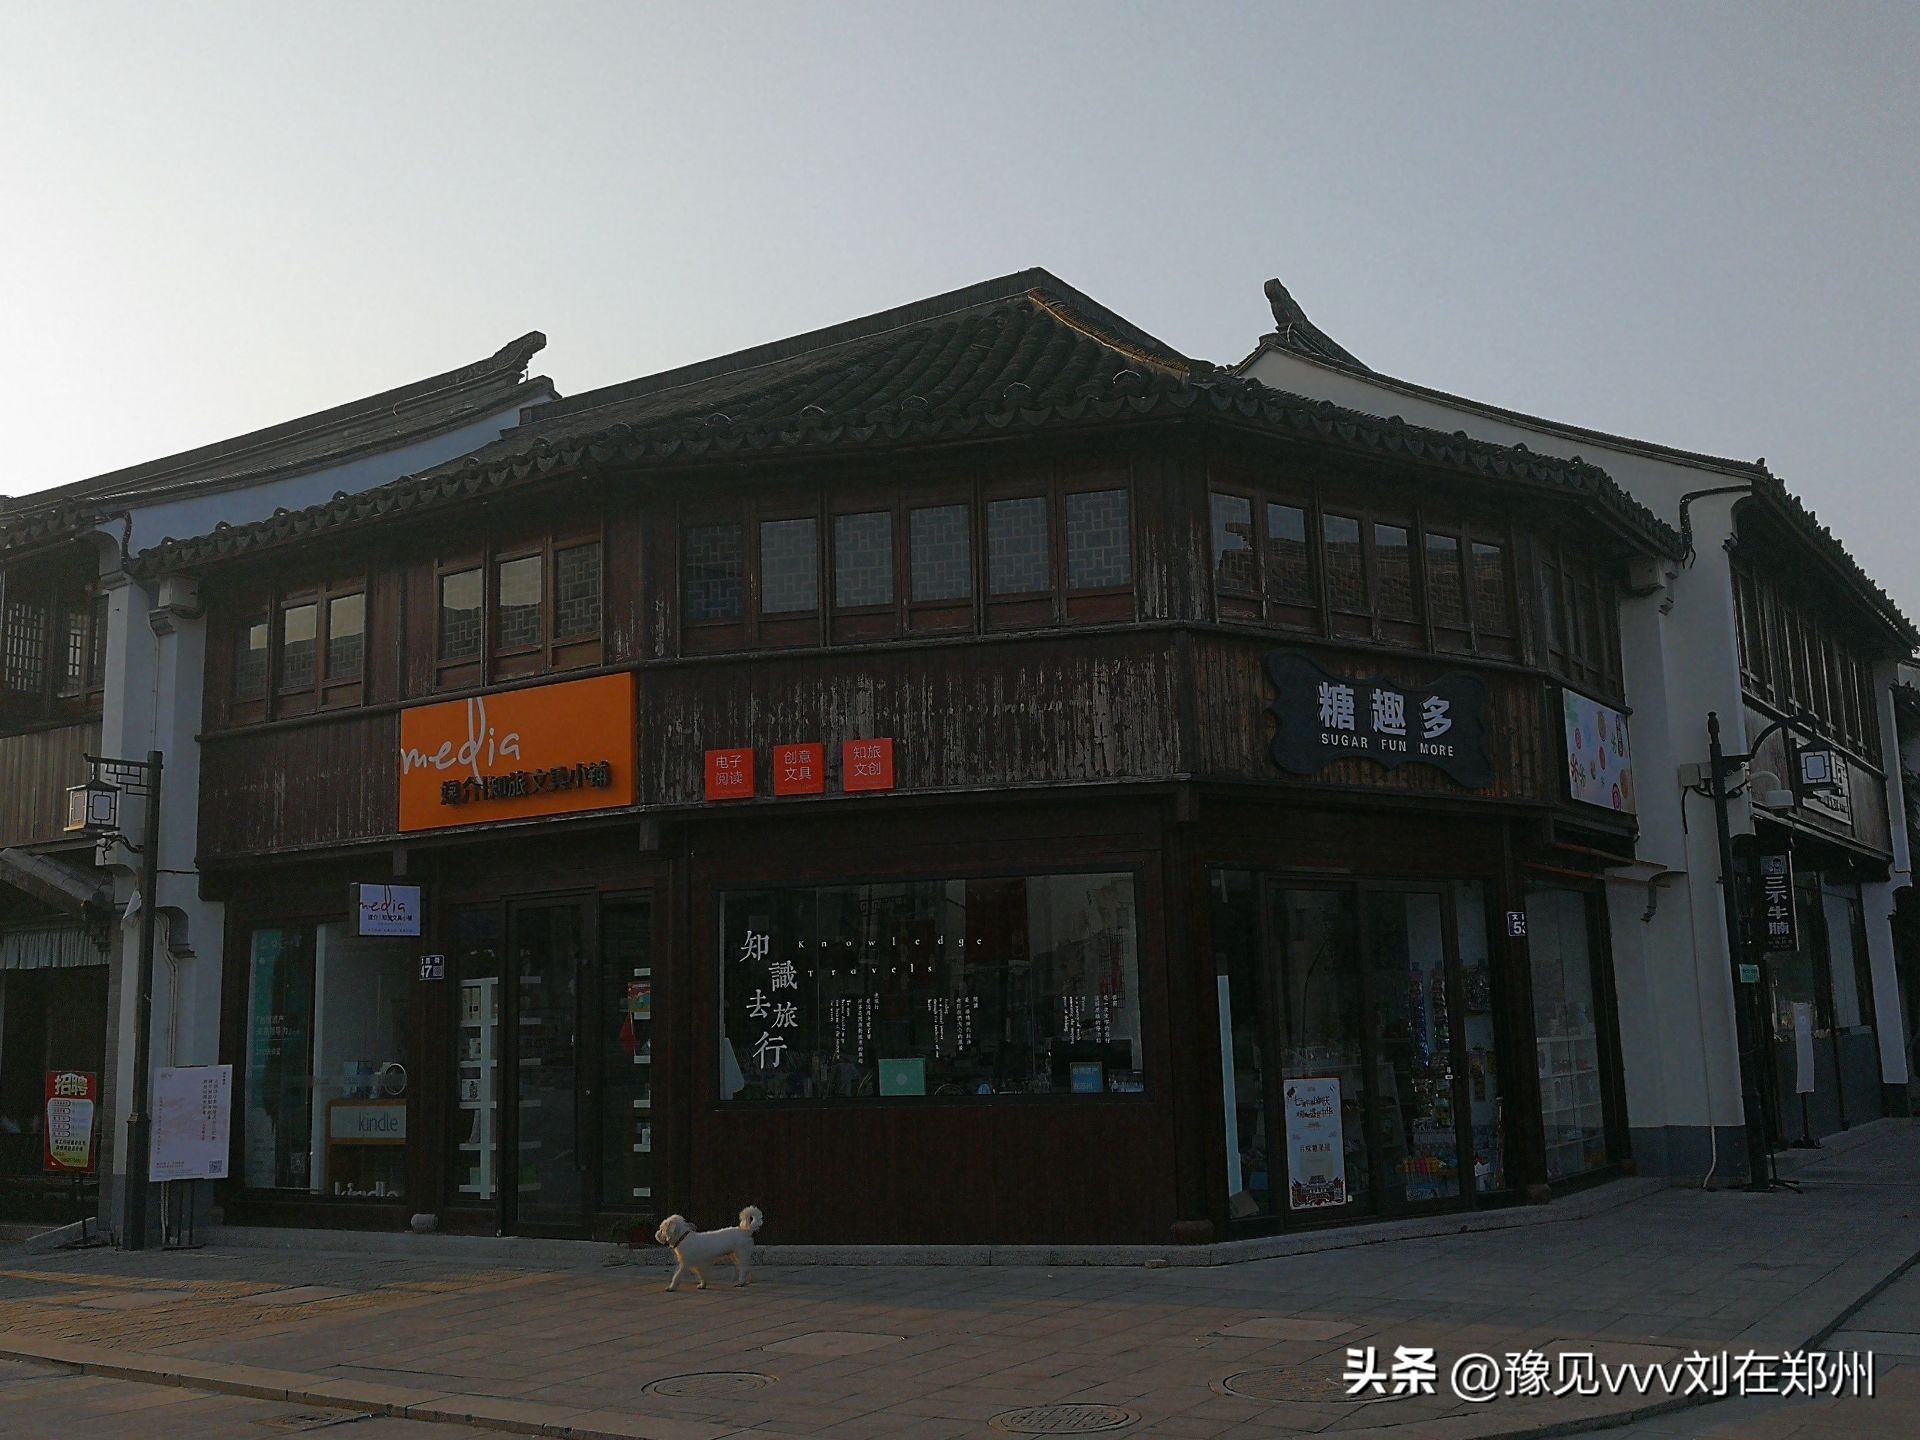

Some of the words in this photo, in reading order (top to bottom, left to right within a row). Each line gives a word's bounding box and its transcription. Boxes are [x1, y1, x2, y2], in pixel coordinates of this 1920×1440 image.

[1317, 681, 1453, 739] 糖趣多
[401, 697, 520, 787] media
[1321, 732, 1369, 749] SUGAR
[1380, 739, 1407, 752] FUN
[1419, 742, 1454, 757] MORE
[715, 754, 742, 769] 电子
[784, 750, 812, 764] 创意
[853, 745, 881, 760] 知旅
[715, 771, 743, 786] 阅读
[784, 766, 812, 782] 文具
[854, 762, 881, 777] 文创
[359, 884, 406, 921] media
[1764, 875, 1790, 935] 三不牛腩
[798, 936, 983, 949] Knowledge
[808, 964, 932, 977] Travels
[739, 930, 799, 1070] 知識去旅行
[54, 1073, 88, 1096] 招聘
[358, 1111, 398, 1132] kindle
